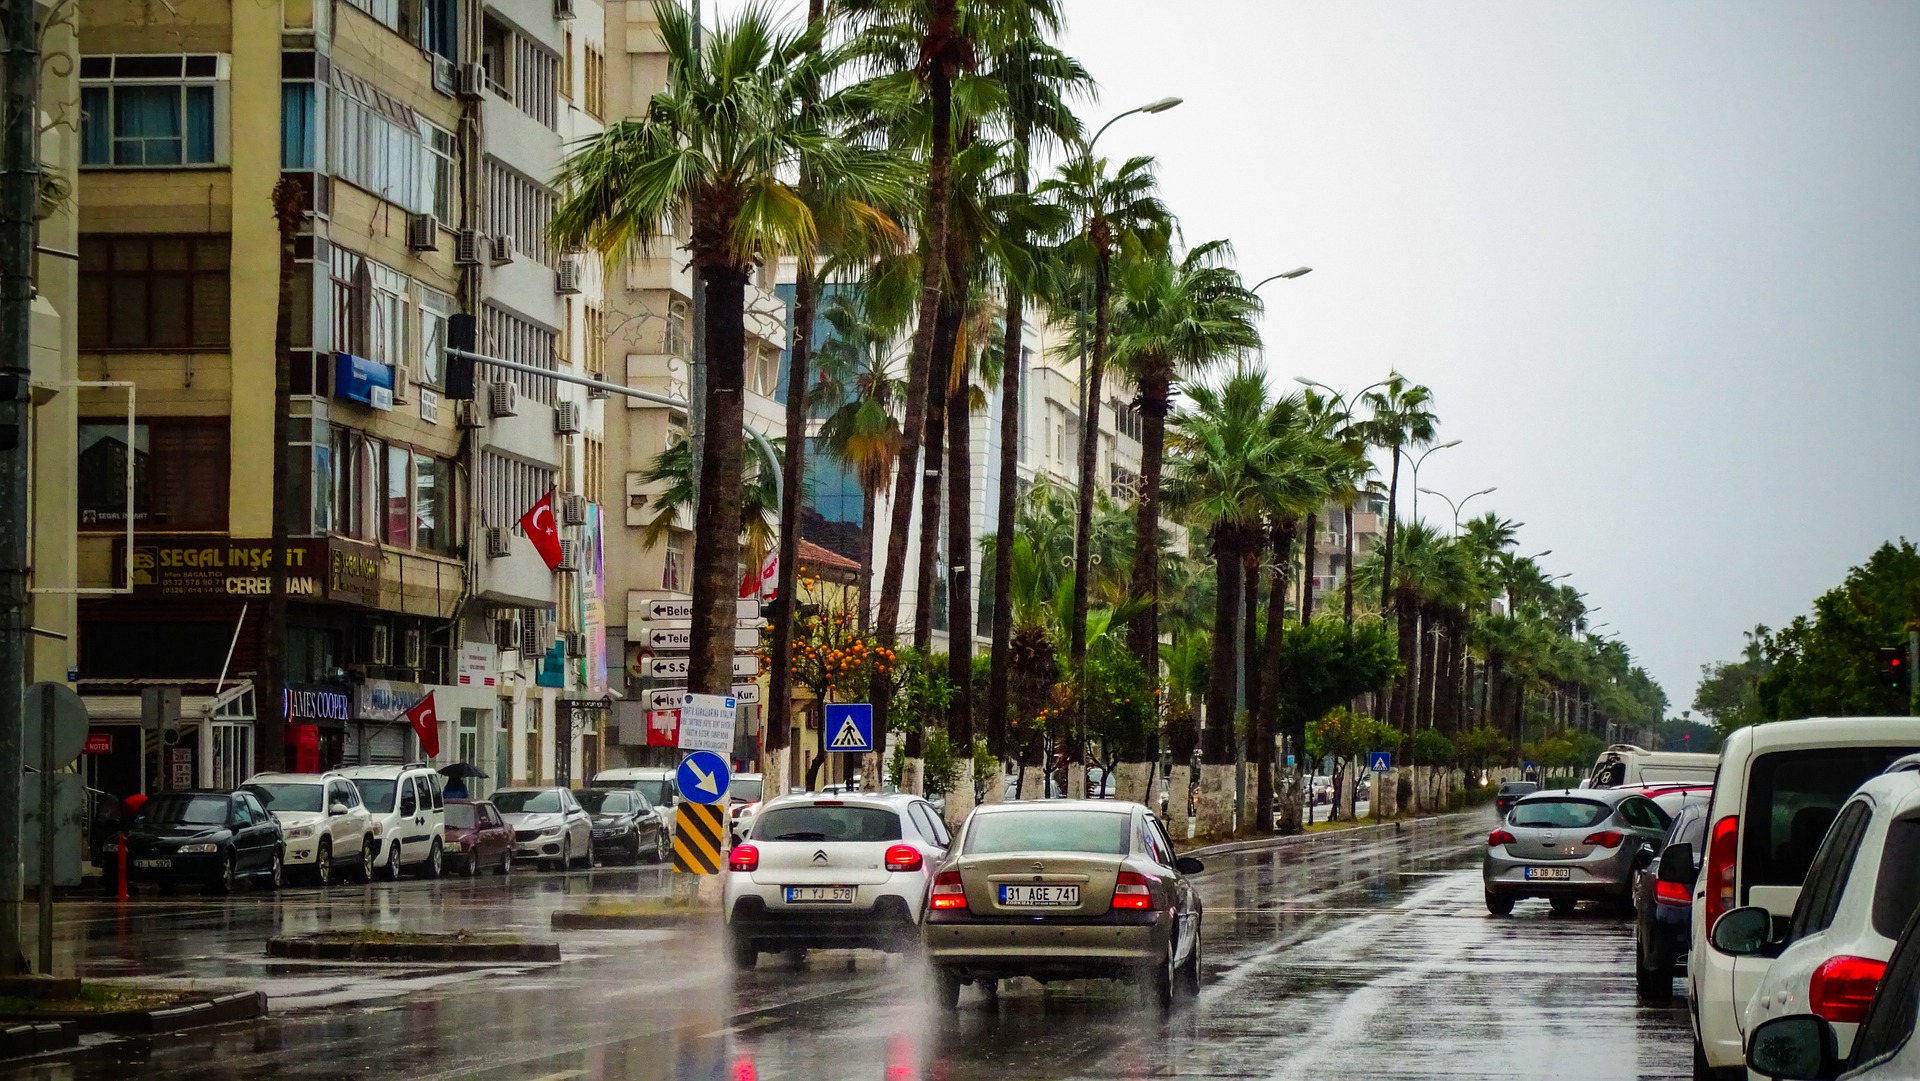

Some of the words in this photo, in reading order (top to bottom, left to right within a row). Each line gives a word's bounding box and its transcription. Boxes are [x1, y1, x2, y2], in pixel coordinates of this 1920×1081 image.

[160, 548, 224, 568] SEGAL
[667, 633, 689, 643] Tele
[737, 690, 755, 700] Kur.
[289, 689, 316, 723] JAMES
[316, 691, 349, 721] COOPER
[89, 743, 109, 751] NOTER
[1529, 868, 1538, 877] 35
[793, 888, 803, 898] 31
[812, 888, 824, 899] YJ
[833, 888, 851, 899] 578
[1008, 887, 1020, 900] 31
[1029, 887, 1050, 900] AGE
[1056, 887, 1076, 901] 741
